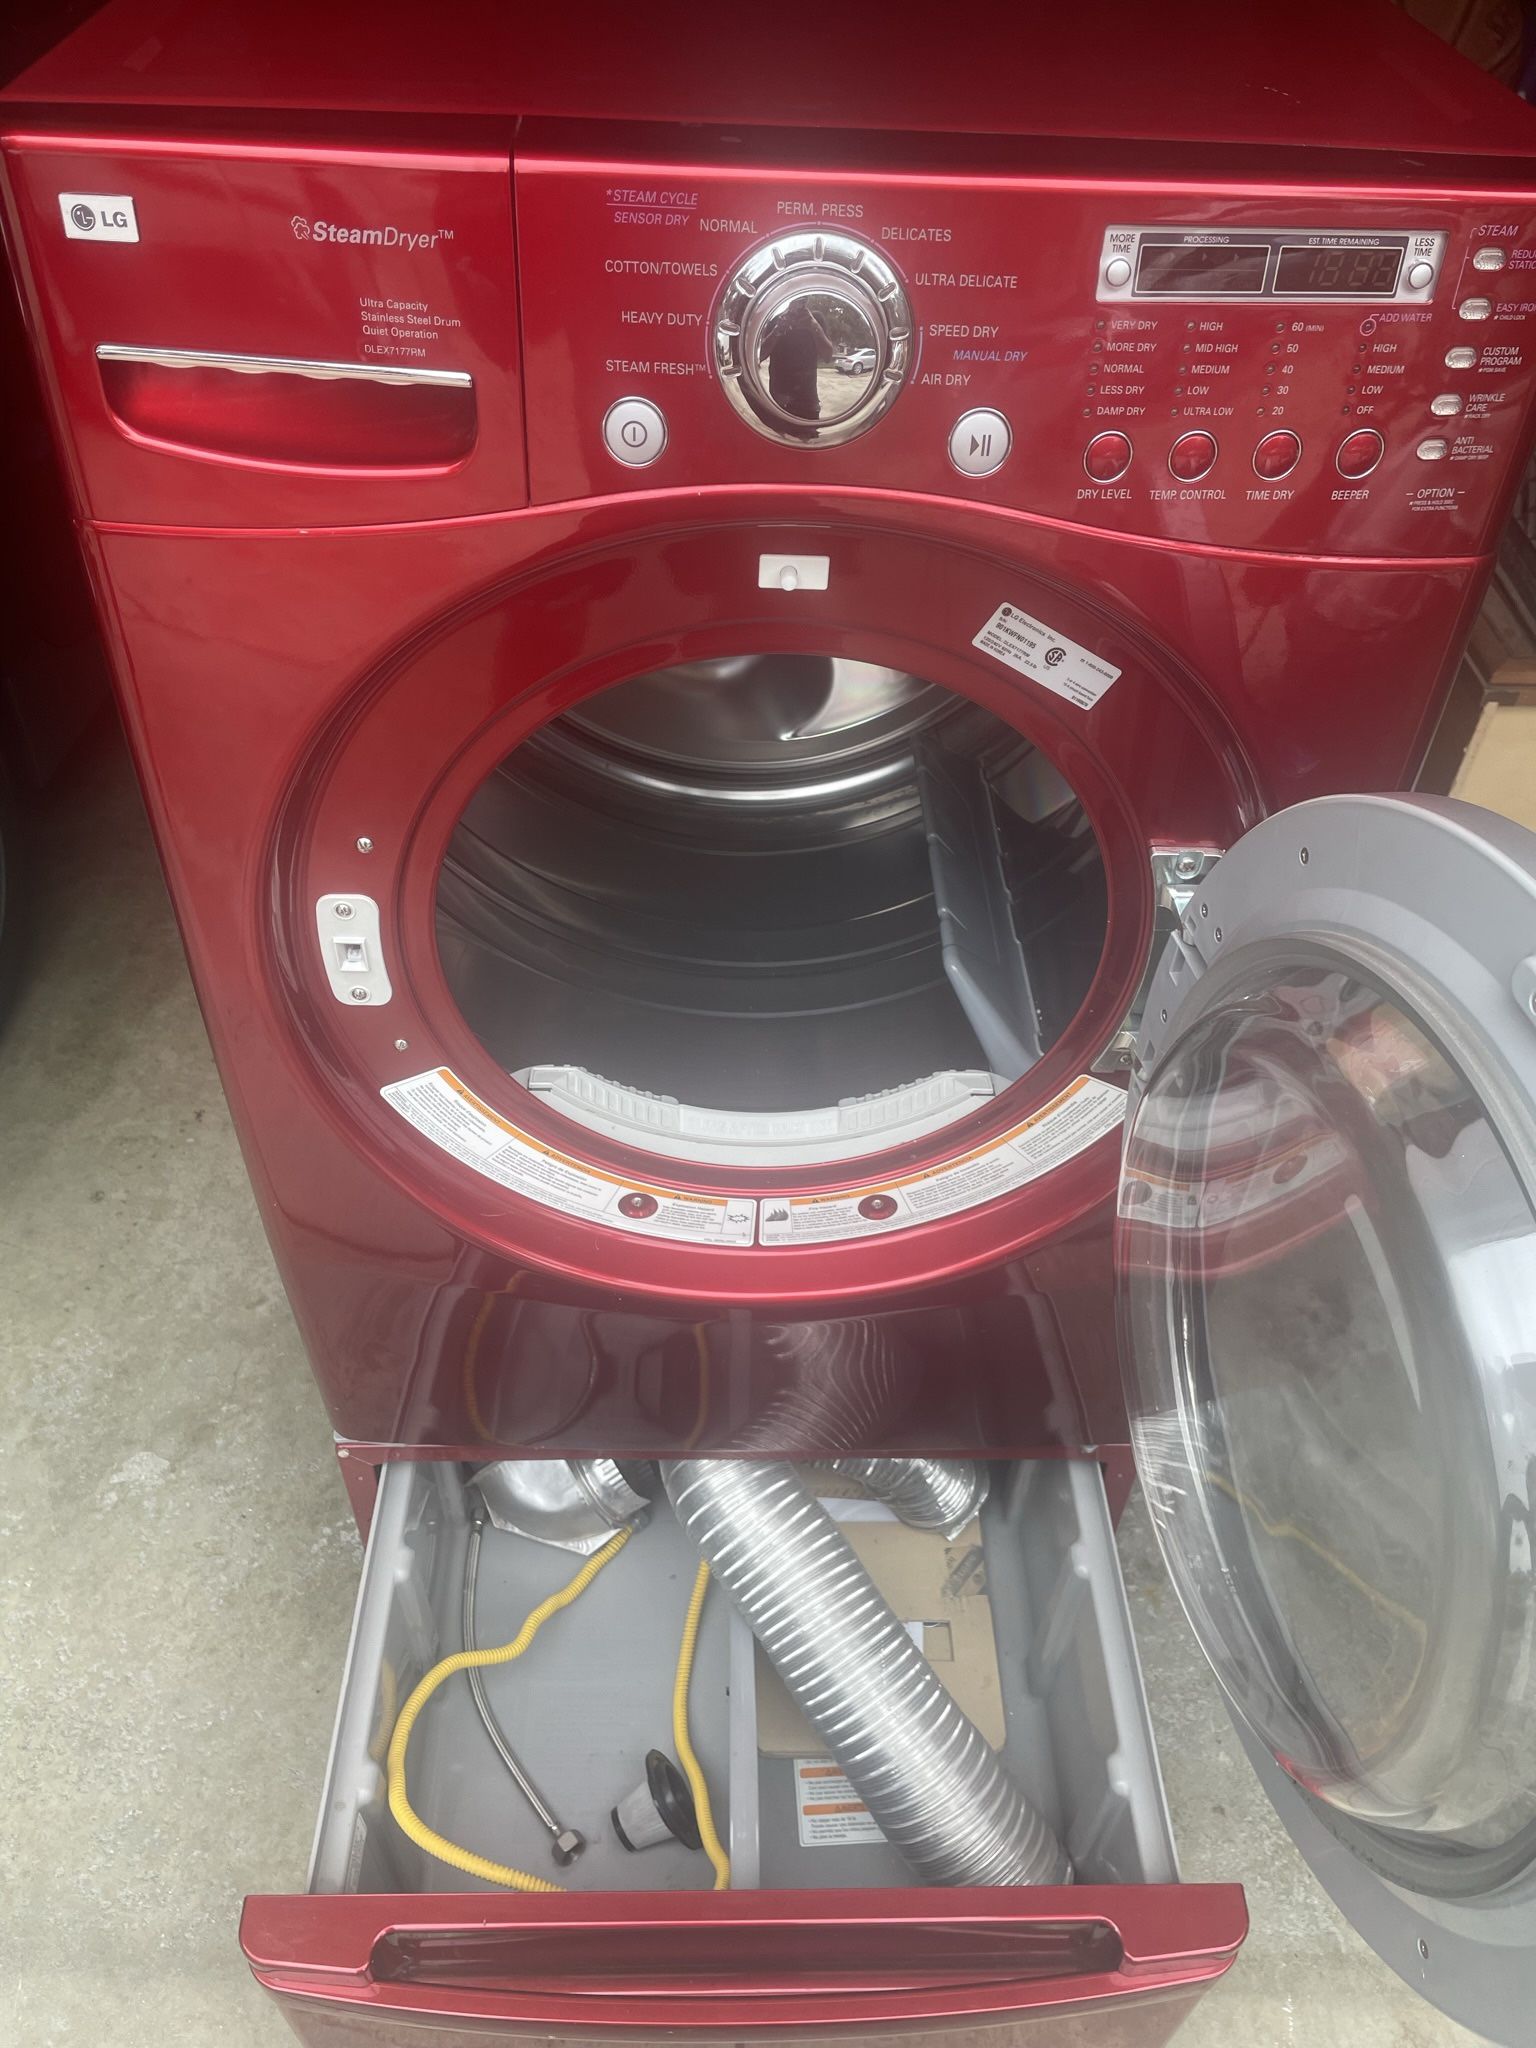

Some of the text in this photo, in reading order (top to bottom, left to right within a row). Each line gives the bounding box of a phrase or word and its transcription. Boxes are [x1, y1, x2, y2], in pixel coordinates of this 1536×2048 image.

[660, 192, 698, 206] CYCLE
[777, 201, 864, 218] PERM. PRESS
[101, 210, 128, 228] LG
[614, 211, 690, 226] SENSOR DRY
[700, 218, 758, 234] NORMAL
[1478, 225, 1519, 236] STEAM
[881, 226, 952, 242] DELICATES
[1109, 233, 1135, 243] MORE
[1183, 235, 1230, 244] PROCESSING
[1338, 238, 1380, 246] REMAINING
[1414, 238, 1435, 247] LESS
[1112, 244, 1131, 253] TIME
[1413, 248, 1432, 256] TIME
[1511, 249, 1536, 259] REDU
[605, 259, 718, 277] COTTON/TOWELS
[915, 272, 1018, 289] ULTRA DELICATE
[360, 298, 428, 313] Ultra Capacity
[1496, 303, 1520, 312] EASY
[360, 311, 461, 327] Stainless Steel Drum
[621, 311, 703, 326] HEAVY DUTY
[1379, 313, 1433, 323] ADD WATER
[1111, 320, 1158, 330] VERY DRY
[1199, 321, 1223, 331] HIGH
[1291, 322, 1325, 333] 60 (MIN)
[362, 325, 439, 340] Quiet Operation
[929, 324, 999, 338] SPEED DRY
[364, 344, 426, 358] DLEX7177RM
[1106, 342, 1157, 352] MORE DRY
[1195, 343, 1238, 353] MID HIGH
[1286, 344, 1299, 353] 50
[1372, 344, 1397, 353] HIGH
[1483, 346, 1519, 356] CUSTOM
[953, 350, 1028, 362] MANUAL DRY
[605, 359, 650, 373] STEAM
[1480, 357, 1522, 366] PROGRAM
[1103, 364, 1144, 374] NORMAL
[1191, 365, 1230, 374] MEDIUM
[1281, 365, 1294, 374] 40
[1366, 365, 1405, 374] MEDIUM
[921, 373, 971, 386] AIR DRY
[1100, 385, 1145, 395] LESS DRY
[1187, 386, 1210, 395] LOW
[1276, 385, 1289, 395] 30
[1361, 385, 1383, 395] LOW
[1469, 393, 1506, 402] WRINKLE
[1096, 406, 1146, 416] DAMP DRY
[1183, 407, 1234, 416] ULTRA LOW
[1271, 406, 1284, 415] 20
[1356, 405, 1374, 415] OFF
[1465, 403, 1488, 413] CARE
[1454, 436, 1475, 445] ANTI
[1451, 445, 1494, 455] BACTERIAL
[1076, 489, 1132, 500] DRY LEVEL
[1149, 489, 1227, 500] TEMP. CONTROL
[1246, 489, 1295, 500] TIME DRY
[1331, 490, 1369, 500] BEEPER
[1417, 488, 1455, 498] OPTION
[1010, 612, 1020, 620] LG
